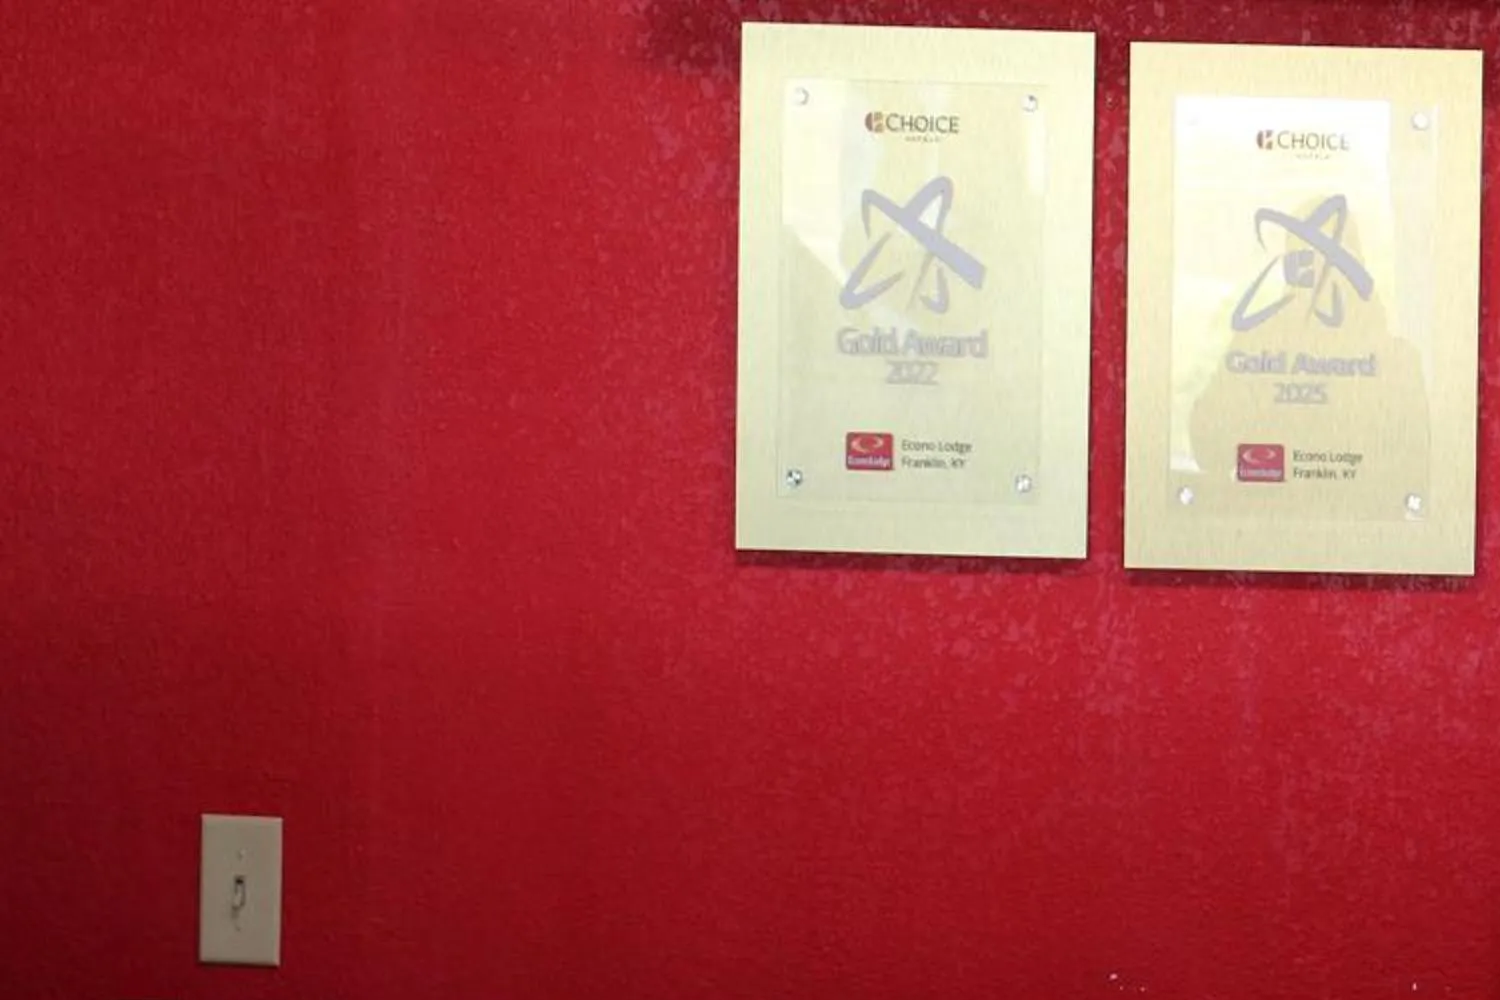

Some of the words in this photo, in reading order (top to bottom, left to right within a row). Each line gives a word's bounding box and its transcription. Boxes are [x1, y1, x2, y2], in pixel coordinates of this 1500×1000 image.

[886, 113, 960, 133] CHOICE
[1277, 130, 1350, 151] CHOICE
[837, 327, 898, 355] Gold
[902, 328, 988, 359] Award
[886, 360, 939, 385] 2022
[1226, 351, 1286, 374] Gold
[1292, 352, 1376, 377] Award
[902, 439, 936, 452] Econo
[938, 440, 972, 455] Lodge
[1293, 450, 1327, 463] Econo
[1329, 451, 1363, 466] Lodge
